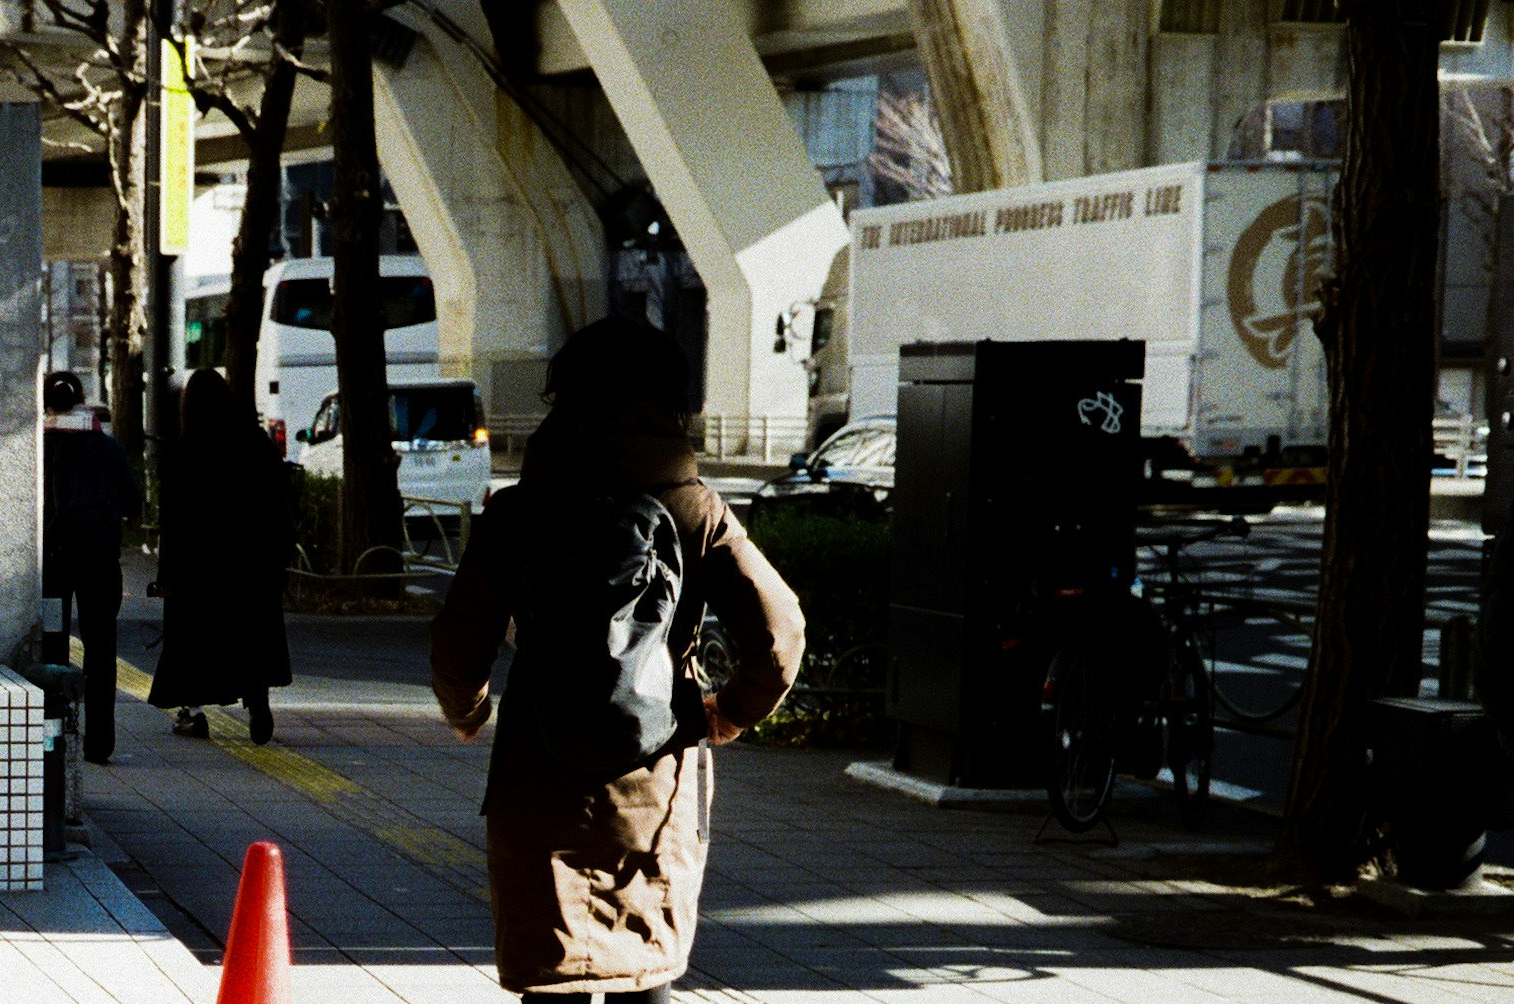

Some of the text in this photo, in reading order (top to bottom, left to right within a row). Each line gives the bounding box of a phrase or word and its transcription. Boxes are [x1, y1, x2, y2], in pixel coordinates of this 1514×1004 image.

[889, 209, 987, 247] INTERNATIONAL
[1072, 190, 1135, 225] TRAFFIC
[1144, 183, 1183, 217] LINE
